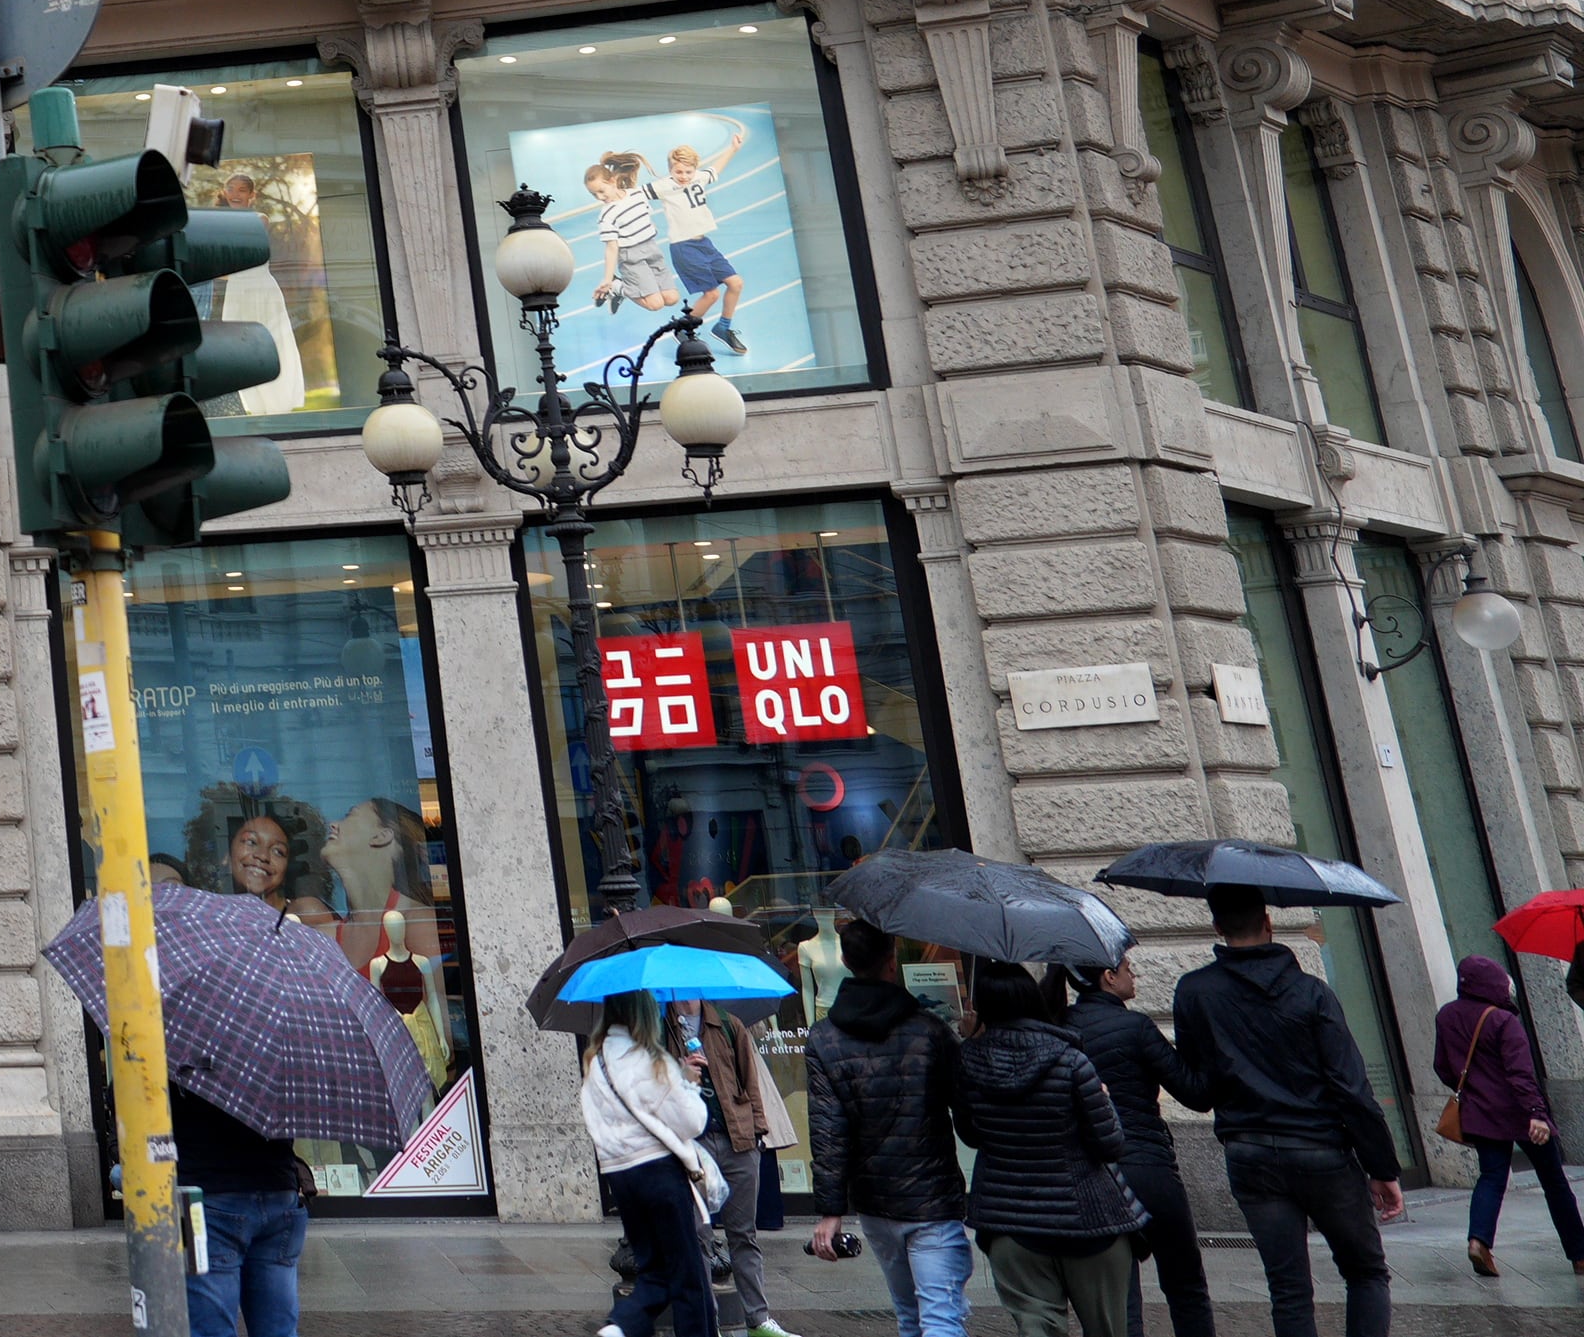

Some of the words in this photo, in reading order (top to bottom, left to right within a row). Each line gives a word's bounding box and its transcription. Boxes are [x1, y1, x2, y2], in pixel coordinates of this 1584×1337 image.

[683, 184, 706, 208] 12
[605, 647, 692, 689] ユニ
[746, 638, 835, 681] UNI
[210, 683, 226, 696] Più
[230, 682, 240, 694] di
[241, 683, 256, 694] un
[257, 679, 312, 695] reggiseno.
[314, 676, 331, 690] Più
[334, 675, 344, 687] di
[346, 675, 360, 686] un
[362, 674, 383, 688] top.
[1056, 672, 1101, 685] PIAZZA
[131, 685, 196, 709] RATOP
[211, 702, 220, 713] Il
[223, 699, 265, 714] meglio
[269, 697, 279, 710] di
[284, 694, 343, 709] entrambi.
[1022, 693, 1147, 715] CORDUSIO
[1226, 694, 1262, 712] DANTE
[609, 695, 698, 737] クロ
[755, 685, 850, 735] QLO
[411, 1124, 452, 1169] FESTIVAL
[423, 1131, 463, 1178] ARIGATO
